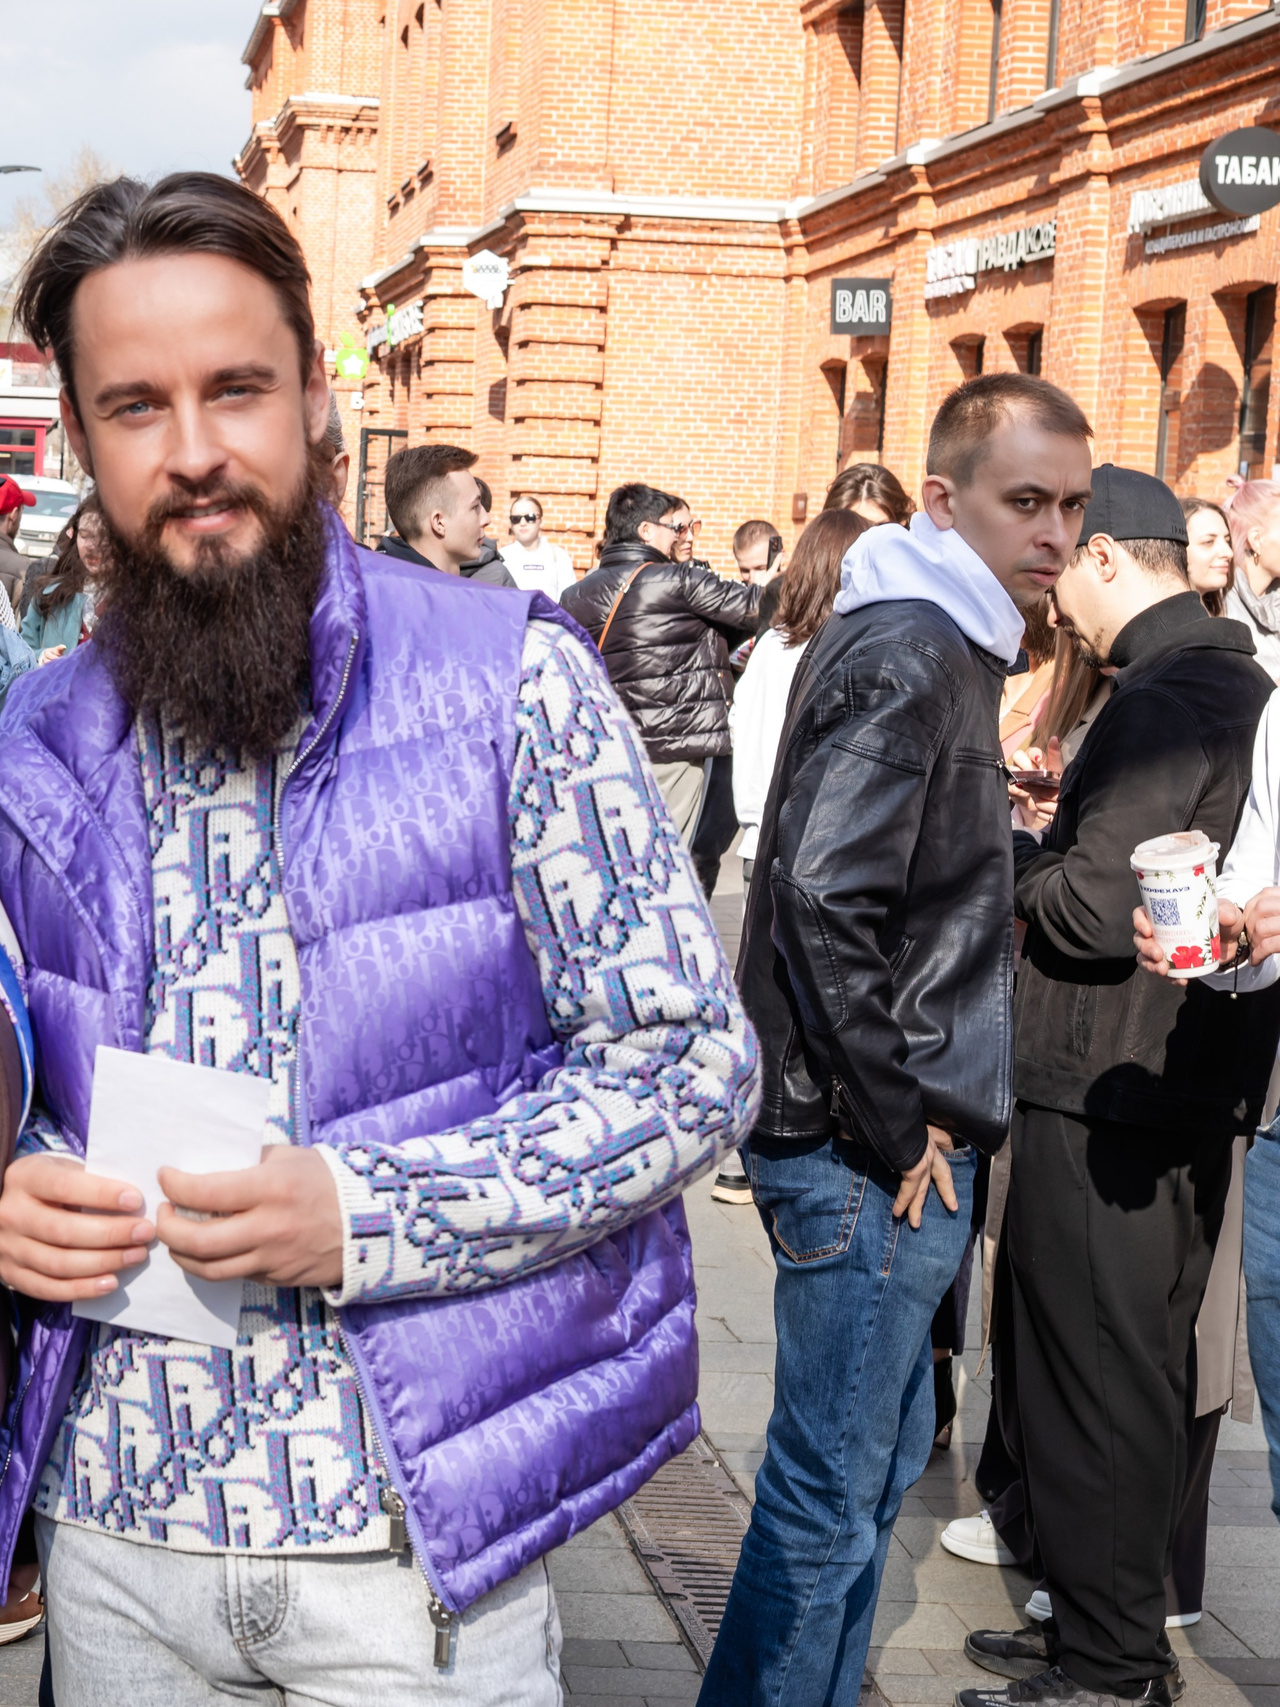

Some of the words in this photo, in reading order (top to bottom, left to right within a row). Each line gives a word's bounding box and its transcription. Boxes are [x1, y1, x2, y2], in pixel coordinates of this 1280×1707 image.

[1215, 154, 1280, 186] ТАБАК
[1205, 213, 1261, 242] ГАСТРОНОМ
[835, 289, 887, 323] BAR
